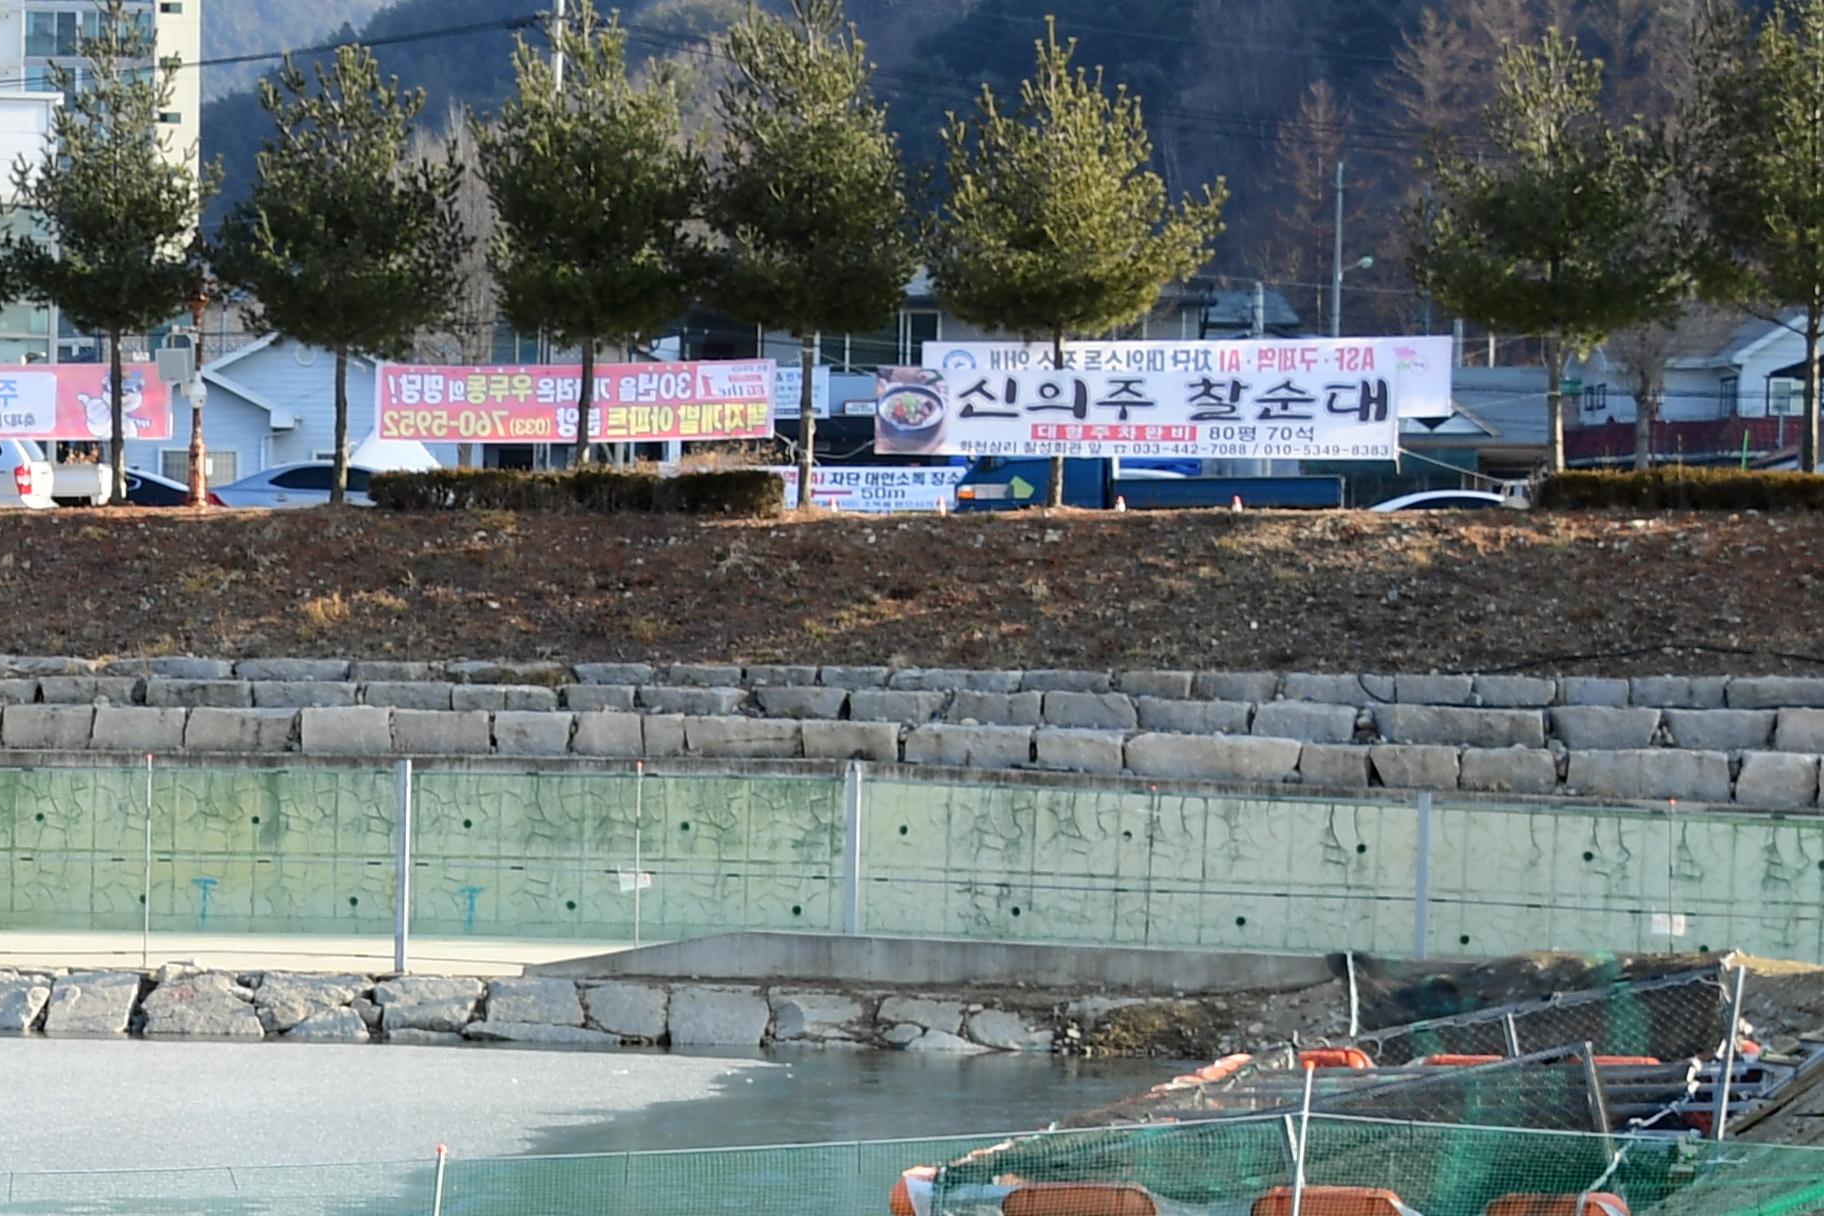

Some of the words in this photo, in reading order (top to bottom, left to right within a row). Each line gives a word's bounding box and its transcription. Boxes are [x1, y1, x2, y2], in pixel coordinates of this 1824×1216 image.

[958, 377, 1155, 421] 신의주
[1188, 377, 1388, 422] 찰순대
[1208, 425, 1257, 442] 80평
[1267, 425, 1315, 442] 70석
[1132, 443, 1247, 456] 033-442-7088
[1263, 443, 1389, 456] 010-5349-8383
[860, 487, 906, 500] 50m
